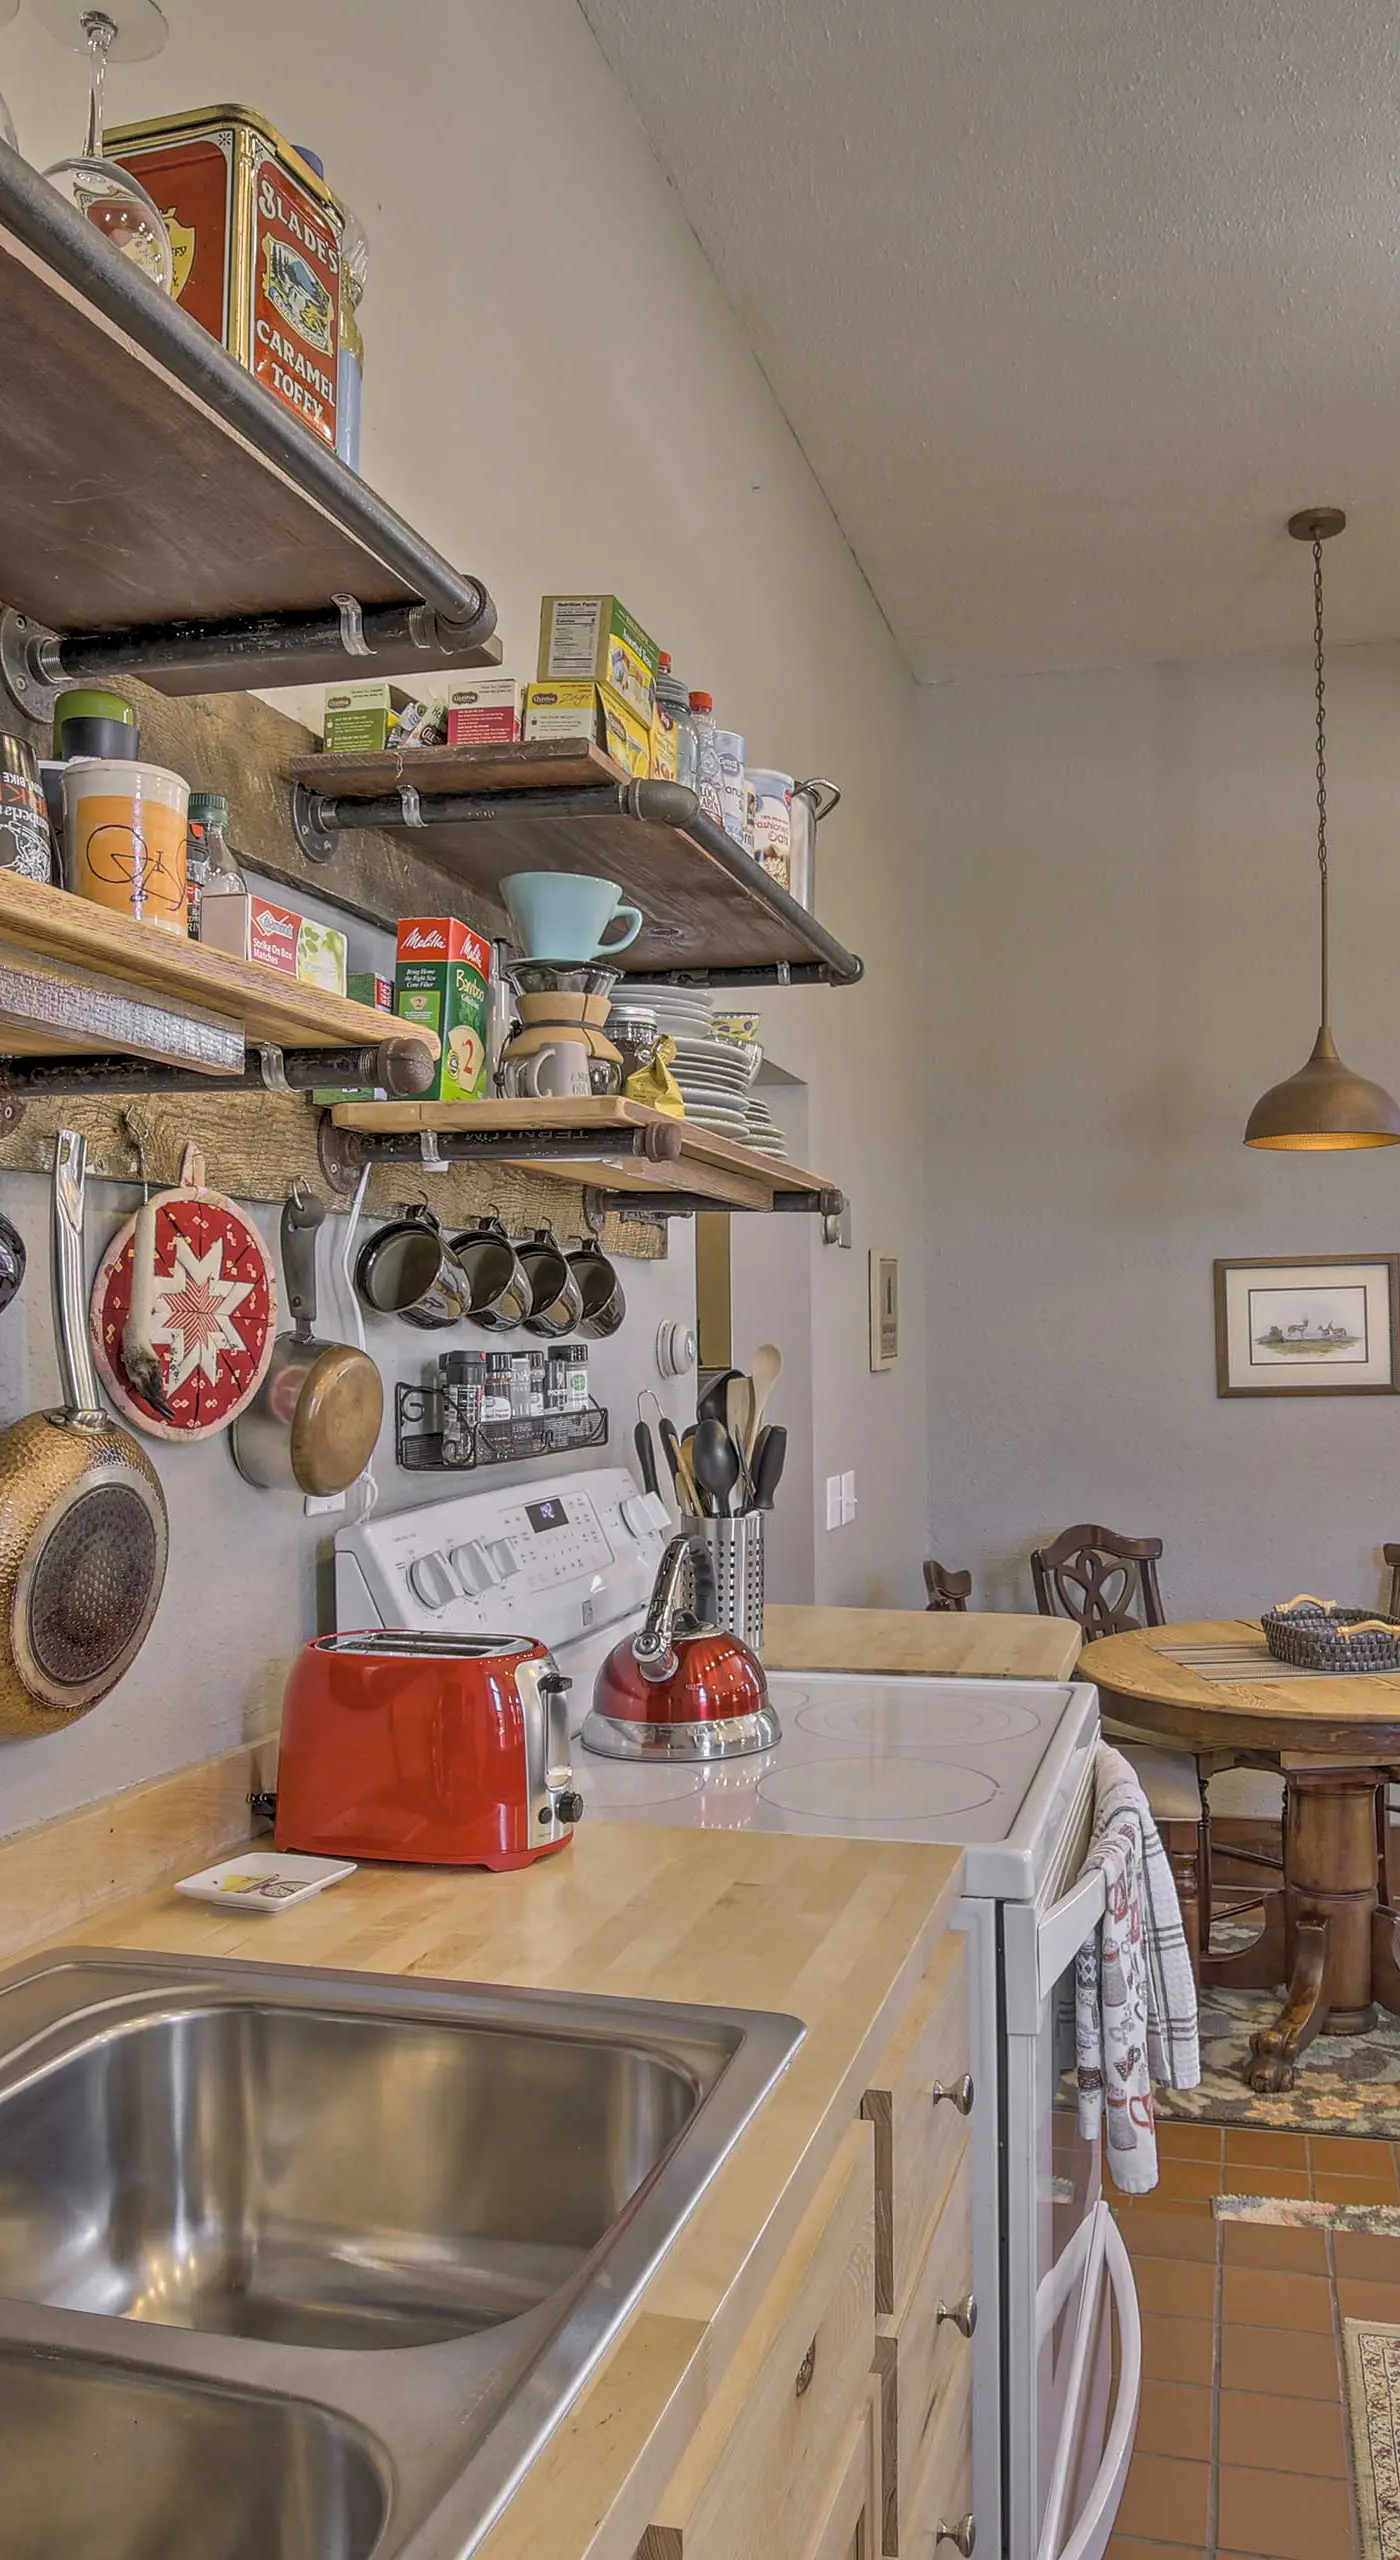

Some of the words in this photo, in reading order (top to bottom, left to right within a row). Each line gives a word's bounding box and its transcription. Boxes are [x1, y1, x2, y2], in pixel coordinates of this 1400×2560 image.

[259, 180, 339, 274] SLADE'S
[256, 319, 336, 407] CARAMEL
[271, 363, 323, 422] TOFFY
[3, 771, 27, 788] BIKE
[253, 937, 271, 952] Strike
[272, 944, 281, 954] On
[281, 947, 293, 961] Box
[400, 927, 447, 949] Melitta
[460, 933, 482, 969] Melitta
[253, 948, 279, 965] Matches
[463, 1039, 474, 1075] 2
